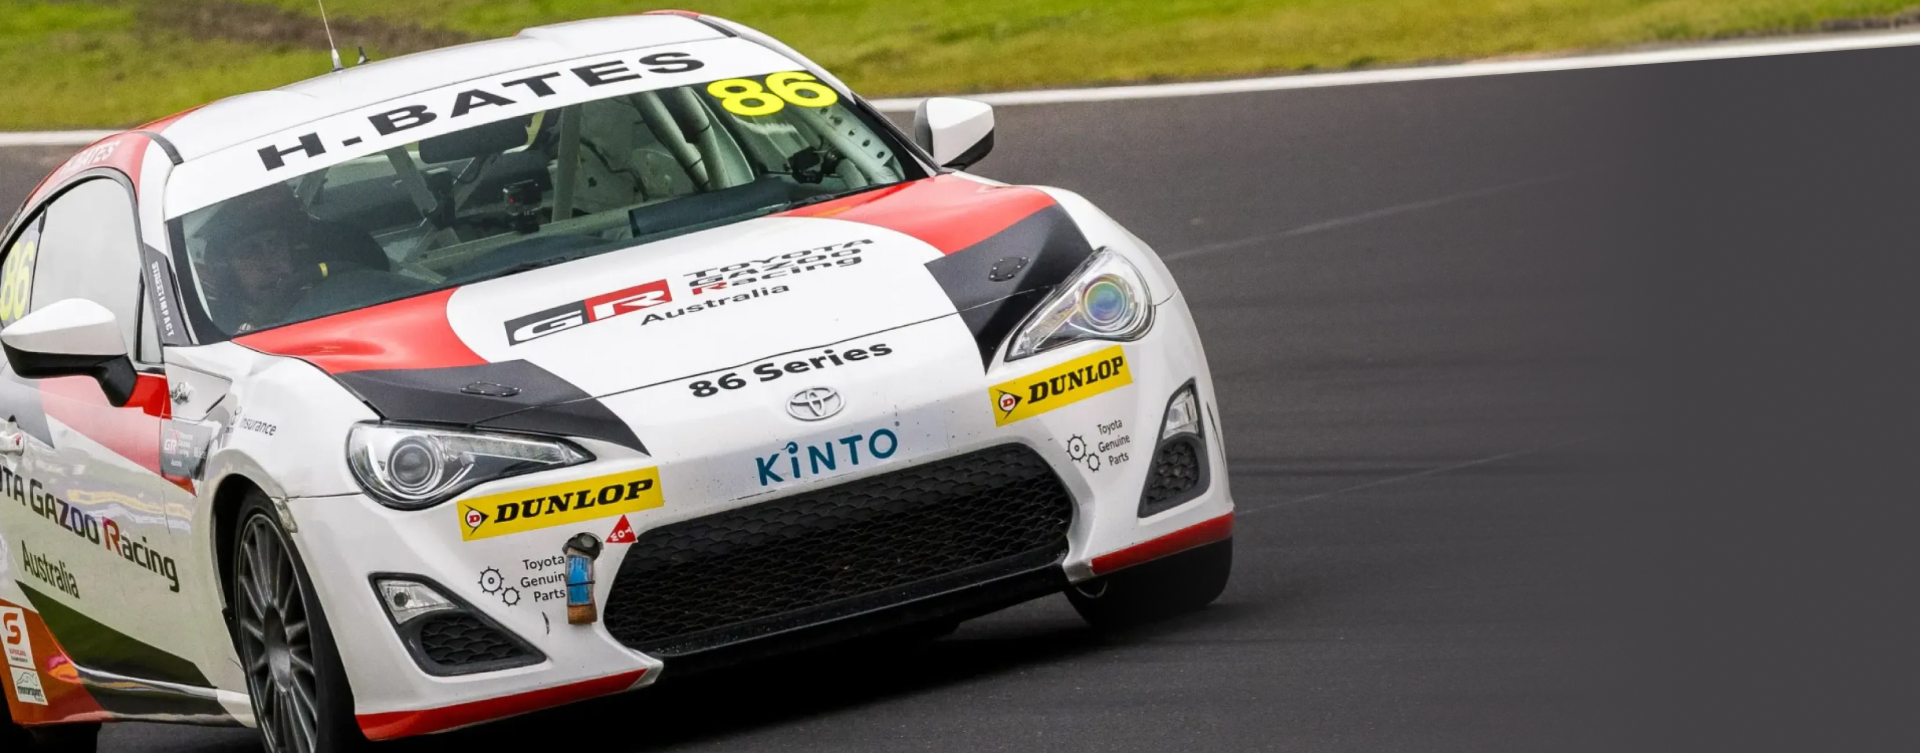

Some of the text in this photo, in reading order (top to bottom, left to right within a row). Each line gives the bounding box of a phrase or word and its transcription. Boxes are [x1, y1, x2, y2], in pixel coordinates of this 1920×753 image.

[707, 71, 837, 116] 86
[683, 239, 874, 278] TOYOTA
[689, 248, 861, 287] GAZOO
[691, 256, 862, 295] Racing
[513, 290, 667, 342] GR
[641, 285, 790, 325] Australia
[689, 343, 893, 398] 86 Series
[1028, 355, 1124, 404] DUNLOP
[1097, 418, 1123, 436] Toyota
[1098, 434, 1131, 453] Genuine
[1108, 453, 1130, 467] Parts
[494, 478, 654, 524] DUNLOP
[29, 478, 100, 545] GAZOO
[102, 516, 180, 593] Racing
[21, 540, 80, 600] Australia
[520, 572, 567, 588] Genuin
[522, 555, 565, 572] Toyota
[534, 588, 566, 602] Parts
